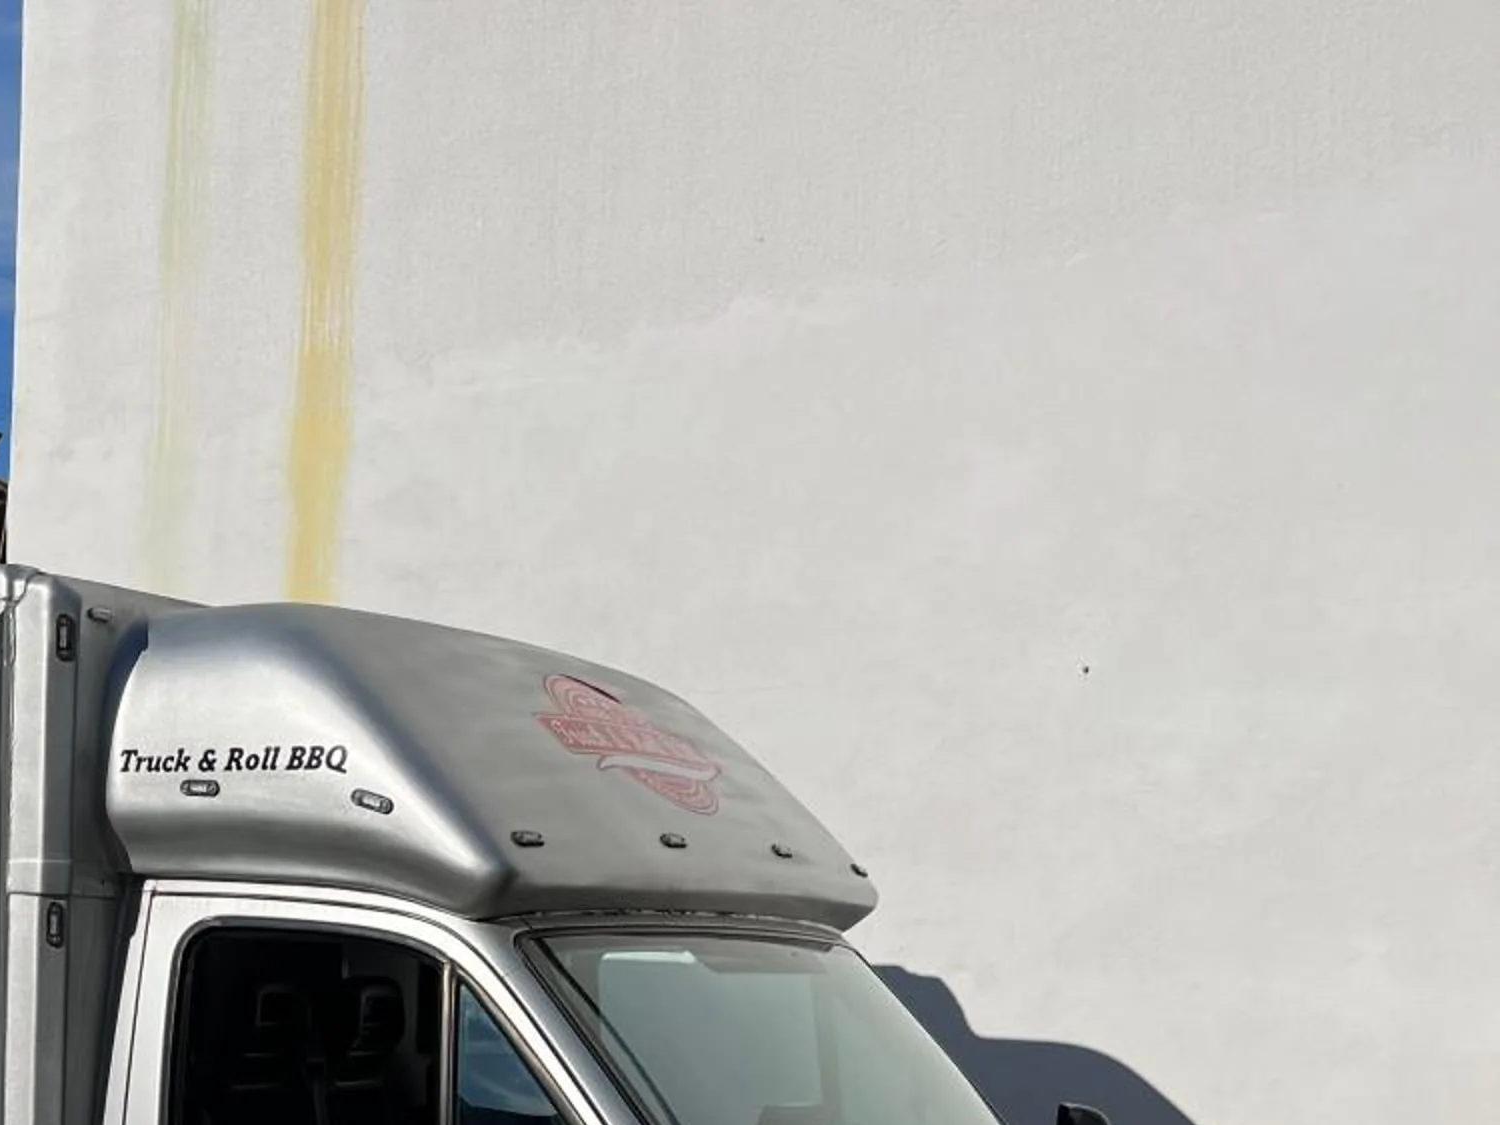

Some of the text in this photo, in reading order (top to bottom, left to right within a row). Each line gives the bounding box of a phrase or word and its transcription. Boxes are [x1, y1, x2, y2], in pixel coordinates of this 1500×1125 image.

[120, 745, 348, 774] Truck & Roll BBQ
